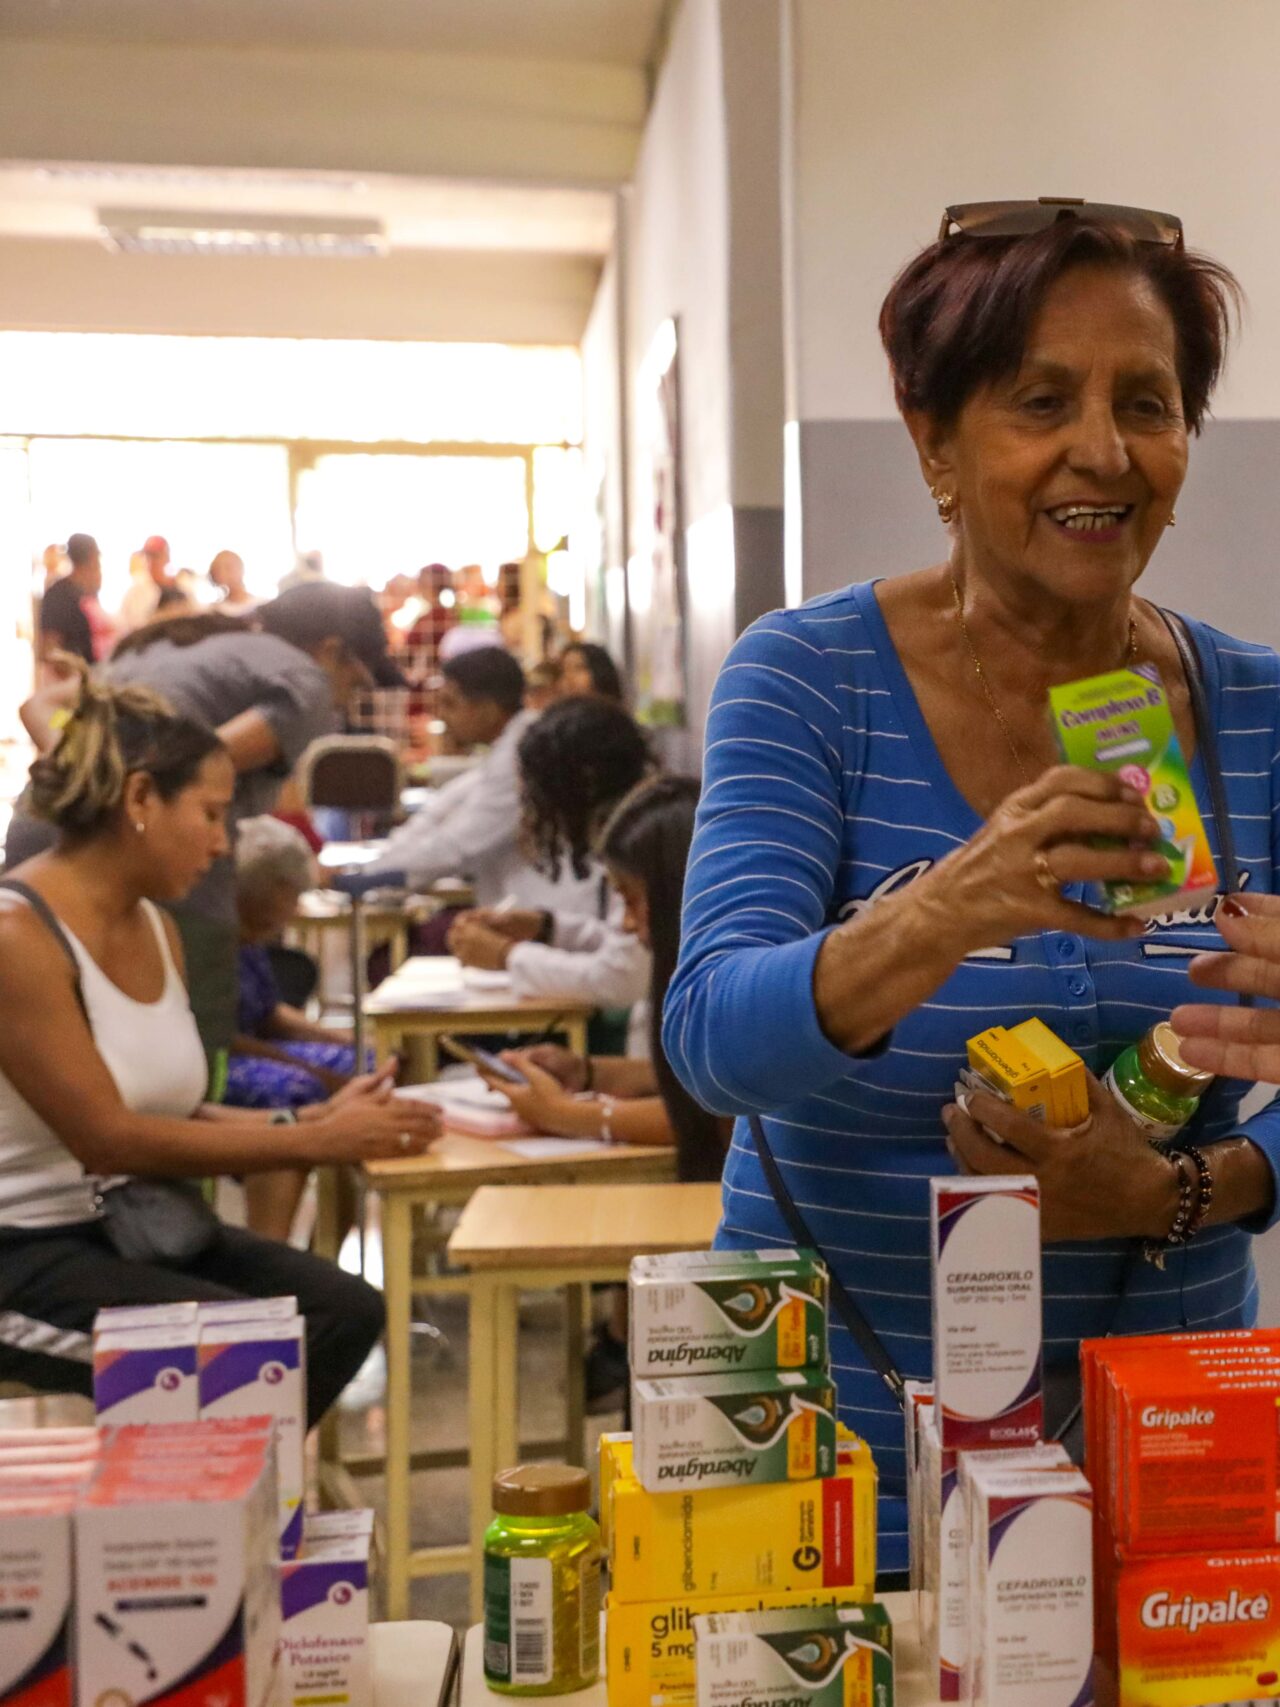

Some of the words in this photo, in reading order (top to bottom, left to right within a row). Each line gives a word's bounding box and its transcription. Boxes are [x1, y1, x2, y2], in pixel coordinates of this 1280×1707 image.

[947, 1270, 1033, 1284] CEFADROXILO
[1006, 1283, 1032, 1293] ORAL
[647, 1343, 748, 1367] Aberalgina
[1141, 1406, 1215, 1430] Gripalce
[658, 1457, 758, 1482] Aberalgina
[996, 1576, 1086, 1591] CEFADROXILO
[1140, 1590, 1270, 1633] Gripalce
[650, 1642, 662, 1658] 5
